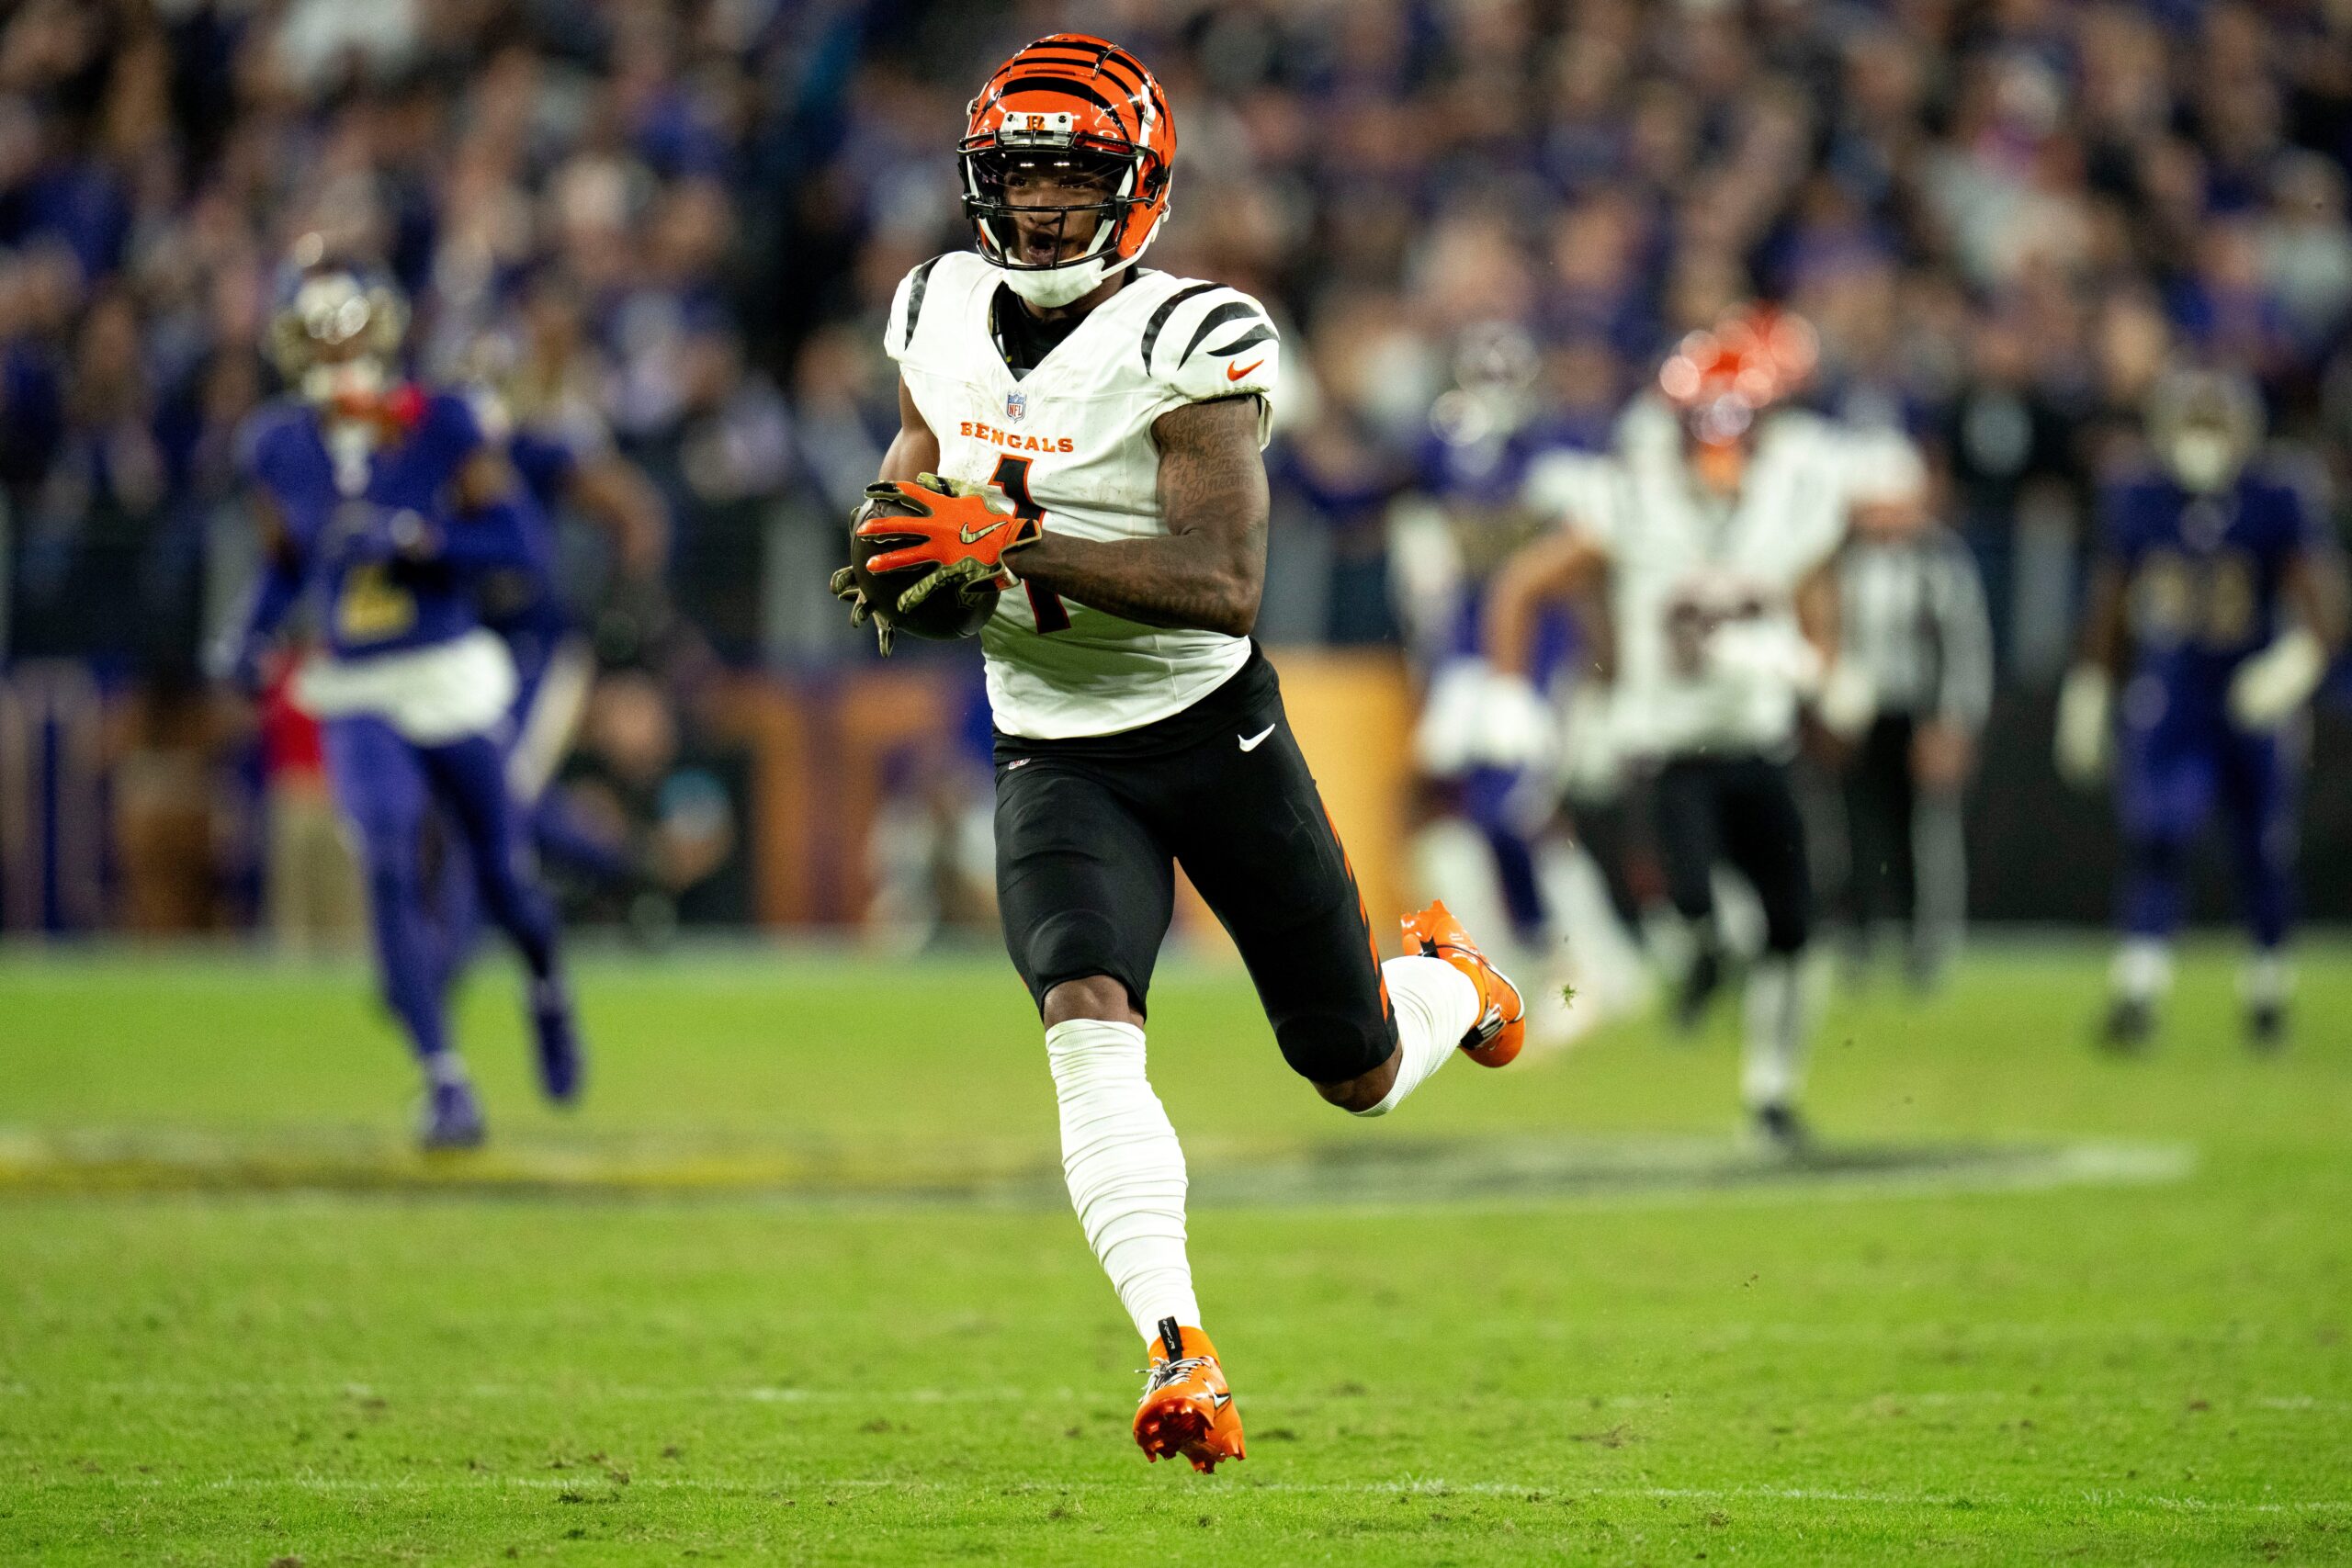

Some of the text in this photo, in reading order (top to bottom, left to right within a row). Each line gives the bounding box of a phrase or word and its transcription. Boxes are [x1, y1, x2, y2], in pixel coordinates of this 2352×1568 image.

[1009, 404, 1023, 417] NFL
[960, 422, 1074, 452] BENGALS
[988, 454, 1072, 634] 1
